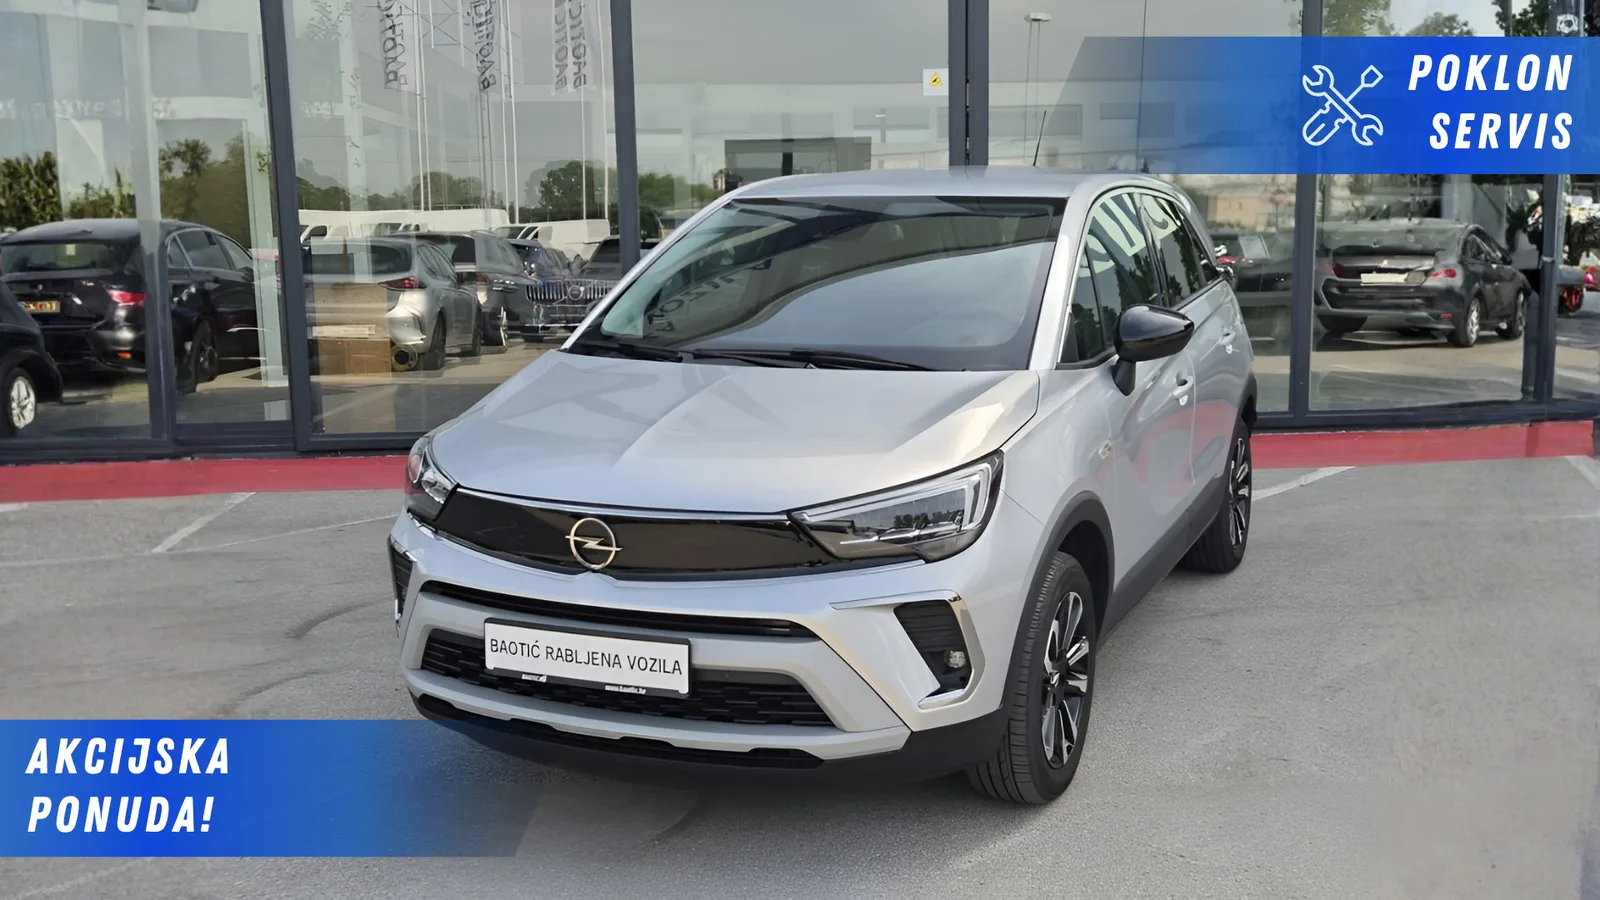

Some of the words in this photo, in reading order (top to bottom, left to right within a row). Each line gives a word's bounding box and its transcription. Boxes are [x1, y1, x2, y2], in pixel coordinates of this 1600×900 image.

[490, 638, 541, 659] BAOTIĆ
[545, 646, 622, 669] RABLJENA
[627, 655, 682, 676] VOZILA
